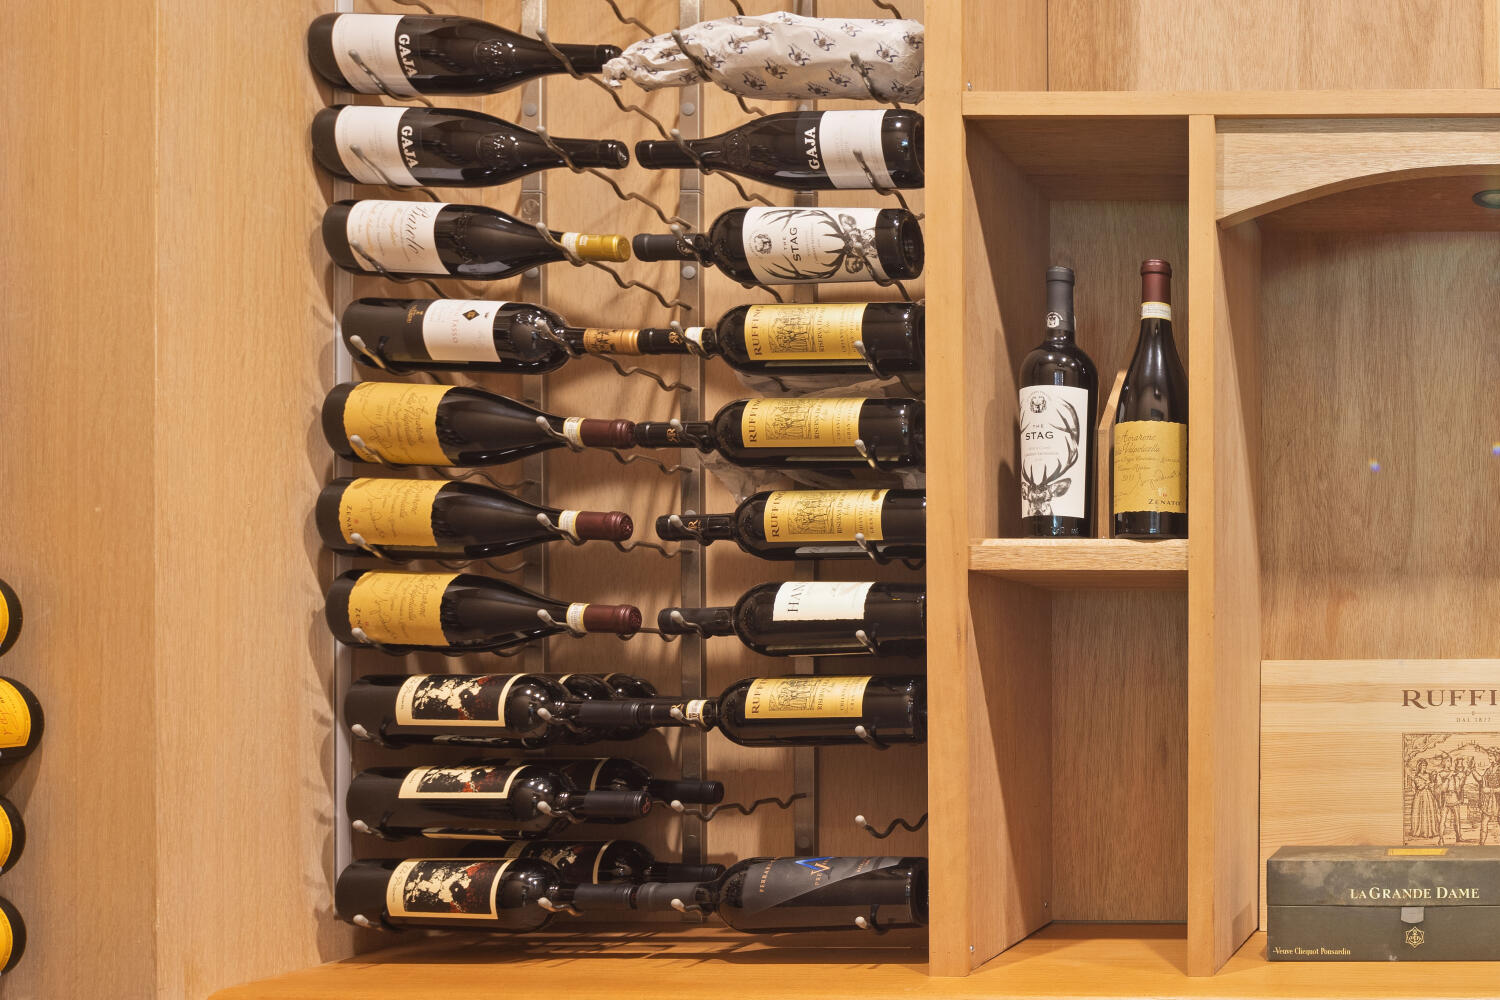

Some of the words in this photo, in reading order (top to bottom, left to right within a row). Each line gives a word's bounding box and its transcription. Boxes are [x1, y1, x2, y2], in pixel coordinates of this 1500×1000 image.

[398, 33, 418, 78] GAJA
[401, 125, 419, 169] GAJA
[804, 126, 820, 170] GAJA
[789, 227, 802, 262] STAG
[1025, 431, 1054, 441] STAG
[1350, 888, 1366, 899] LA
[1369, 887, 1432, 900] GRANDE
[1436, 886, 1481, 899] DAME
[1273, 947, 1293, 955] Veuve
[1320, 947, 1351, 955] Ponsardin
